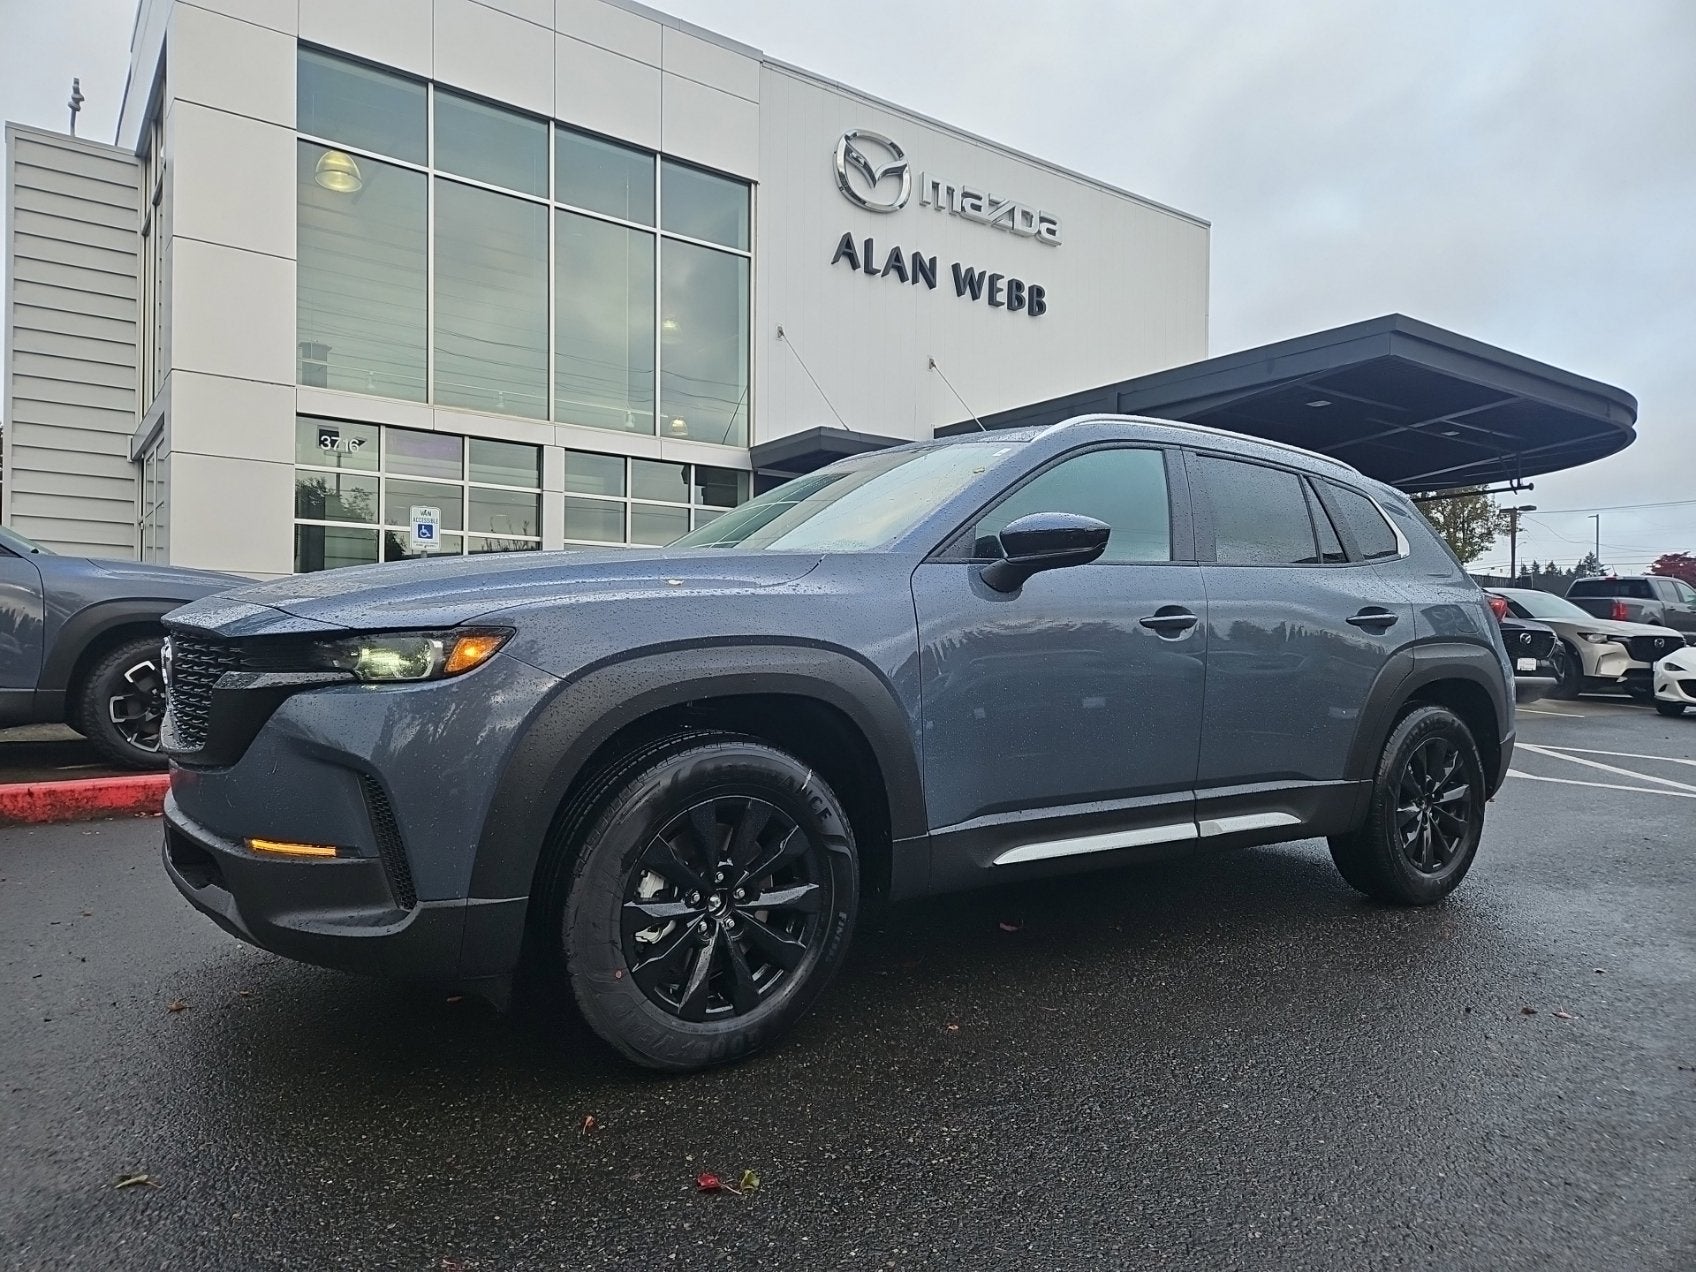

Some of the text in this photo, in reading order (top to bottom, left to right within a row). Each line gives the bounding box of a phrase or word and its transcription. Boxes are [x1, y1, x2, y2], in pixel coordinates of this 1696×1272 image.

[831, 232, 1047, 316] ALAN WEBB
[320, 435, 360, 453] 3716
[420, 509, 432, 517] VAN
